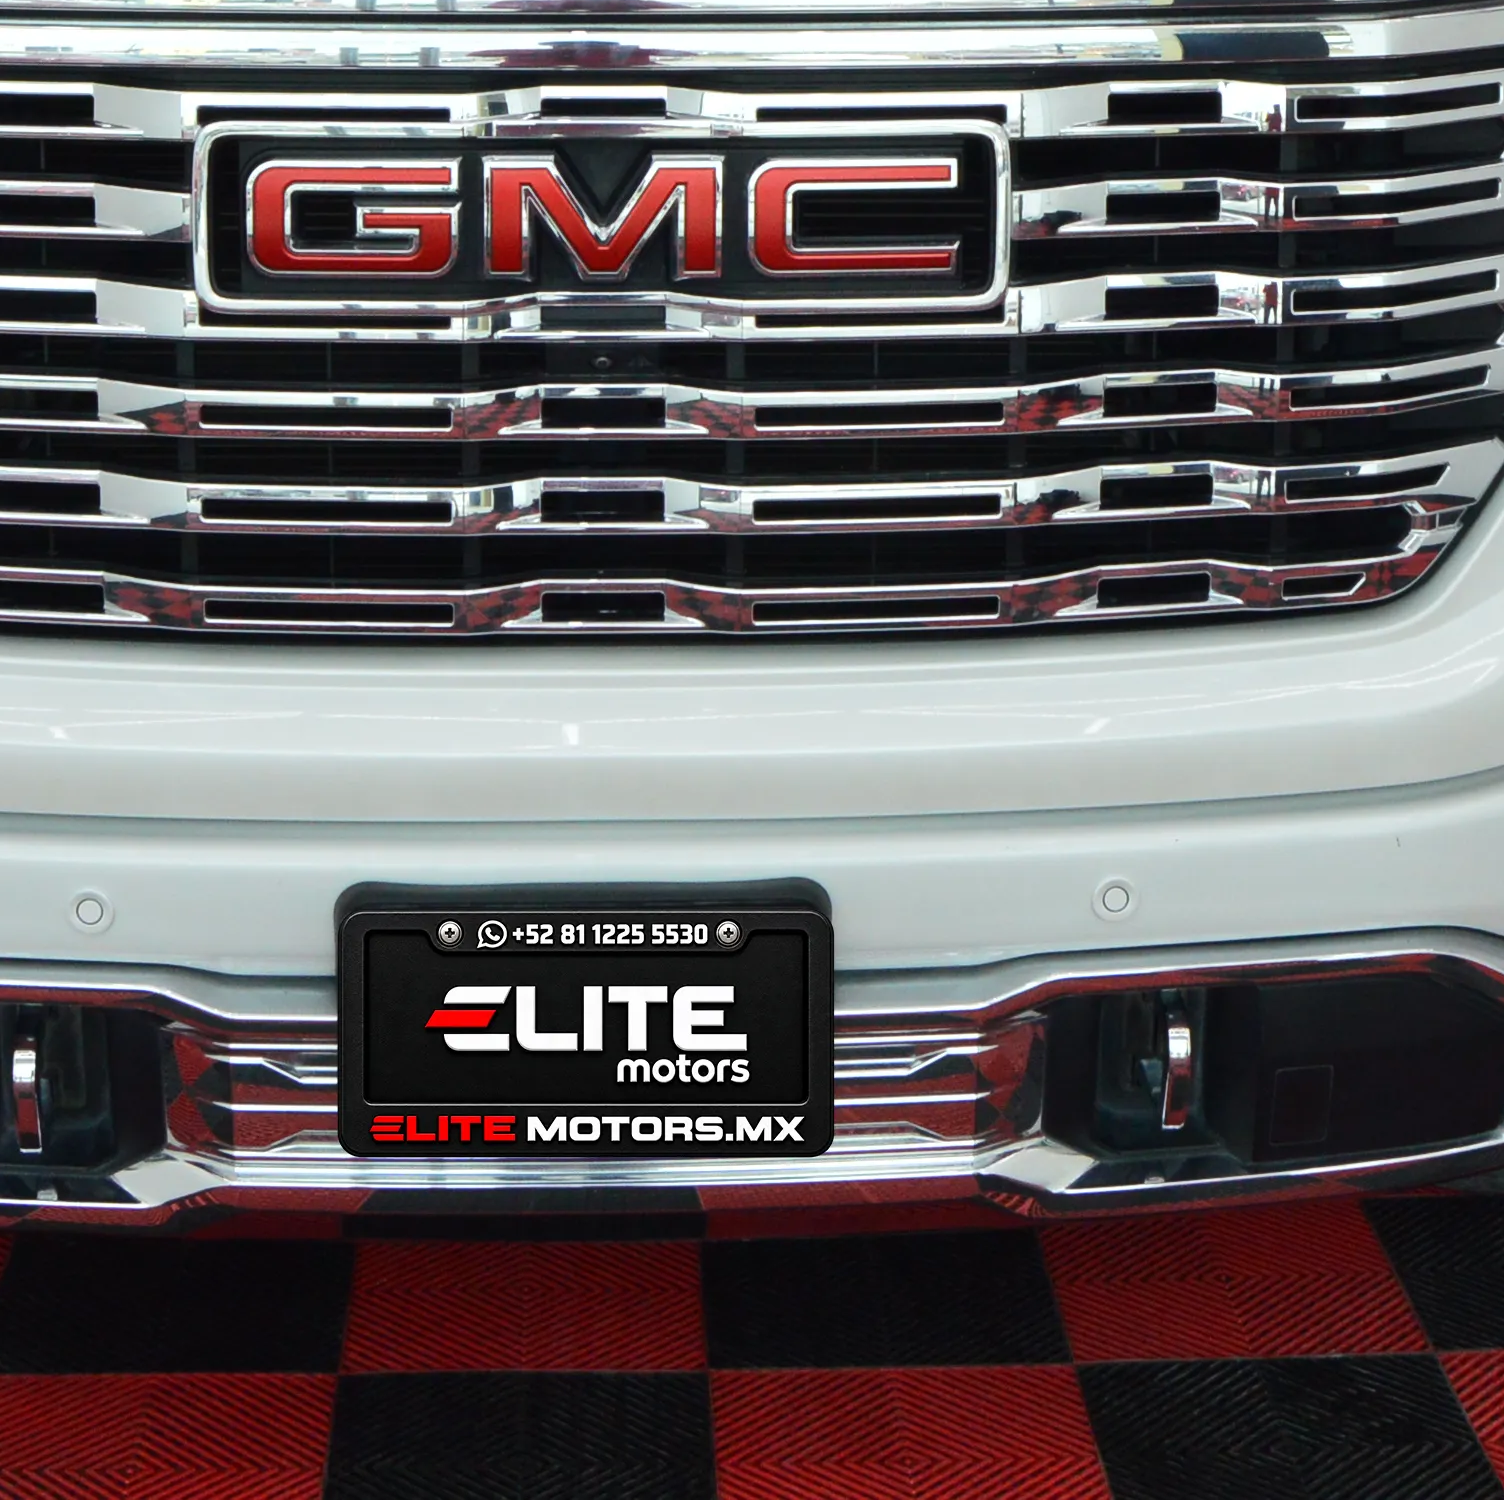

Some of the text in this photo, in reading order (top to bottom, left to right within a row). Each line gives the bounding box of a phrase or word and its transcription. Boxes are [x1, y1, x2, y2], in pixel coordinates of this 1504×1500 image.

[246, 154, 962, 283] GMC
[512, 923, 708, 945] +52 81 1225 5530
[425, 985, 748, 1051] ELITE
[616, 1054, 750, 1083] motors
[369, 1115, 805, 1141] ELITE MOTORS.MX
